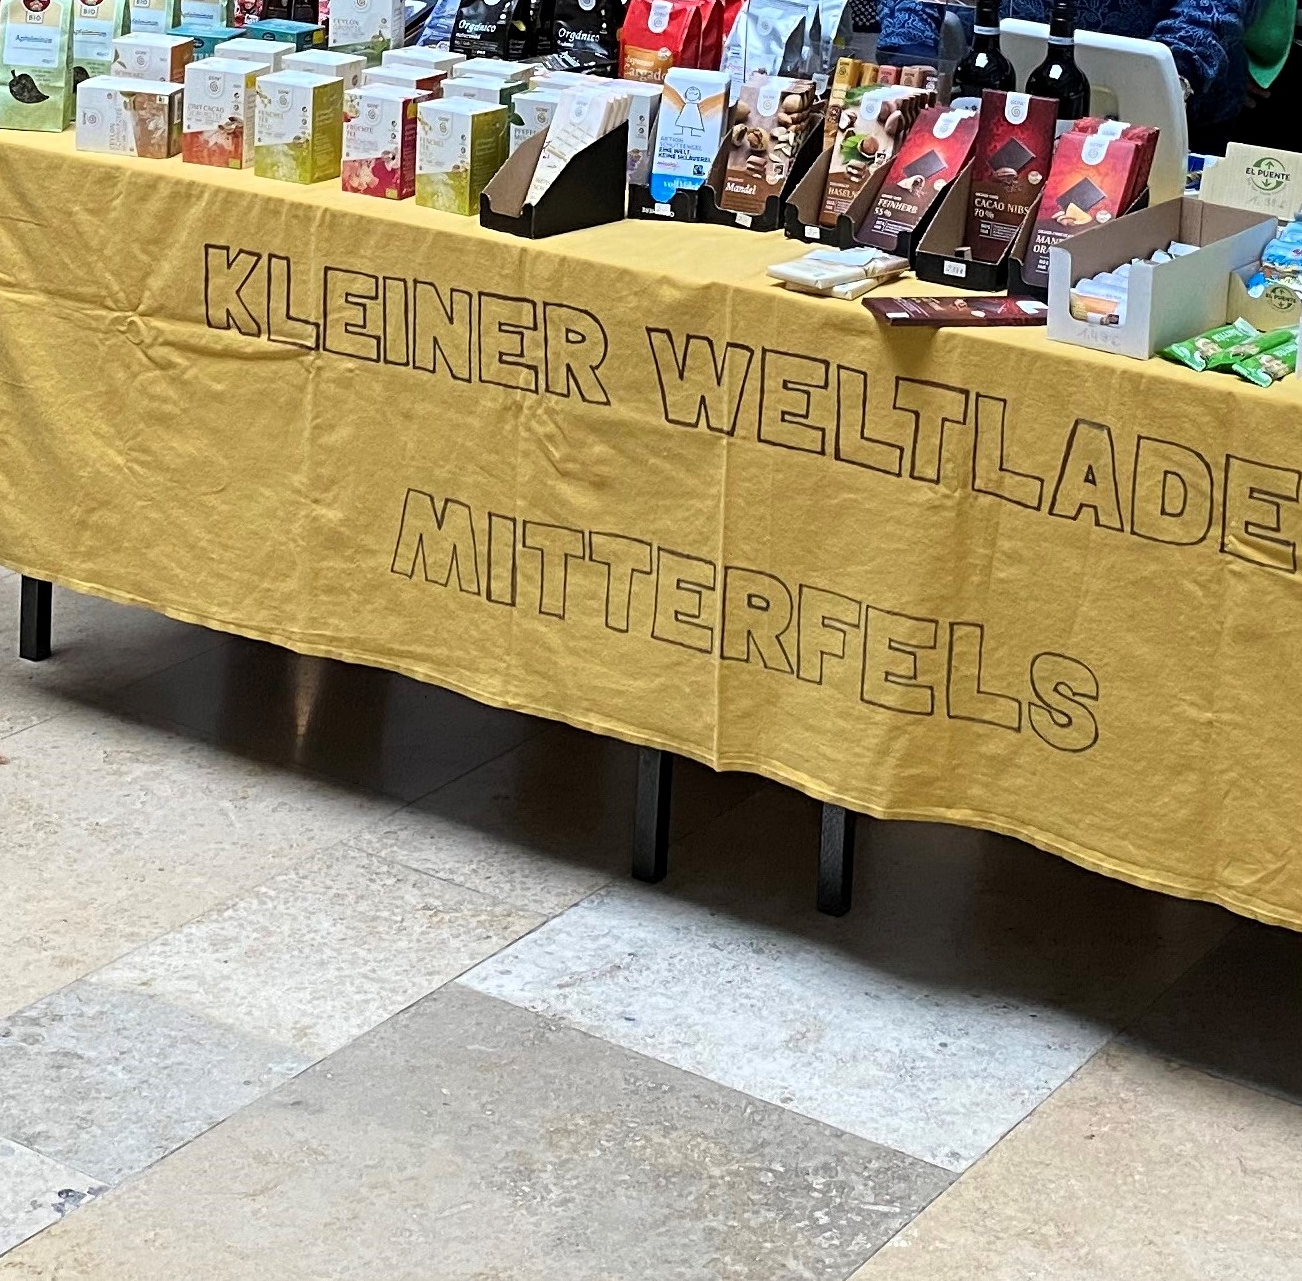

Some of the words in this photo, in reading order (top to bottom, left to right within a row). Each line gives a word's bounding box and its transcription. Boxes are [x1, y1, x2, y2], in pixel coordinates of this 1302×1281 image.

[458, 19, 497, 34] Orgánico
[558, 27, 601, 43] Orgánico
[1245, 167, 1255, 175] EL
[1257, 169, 1291, 182] PUENTE
[725, 181, 757, 195] Mandel
[877, 199, 919, 215] FEINHERB
[974, 197, 1005, 211] CACAO
[1007, 203, 1030, 215] NIBS
[202, 241, 611, 406] KLEINER
[390, 487, 1101, 754] MITTERFELS
